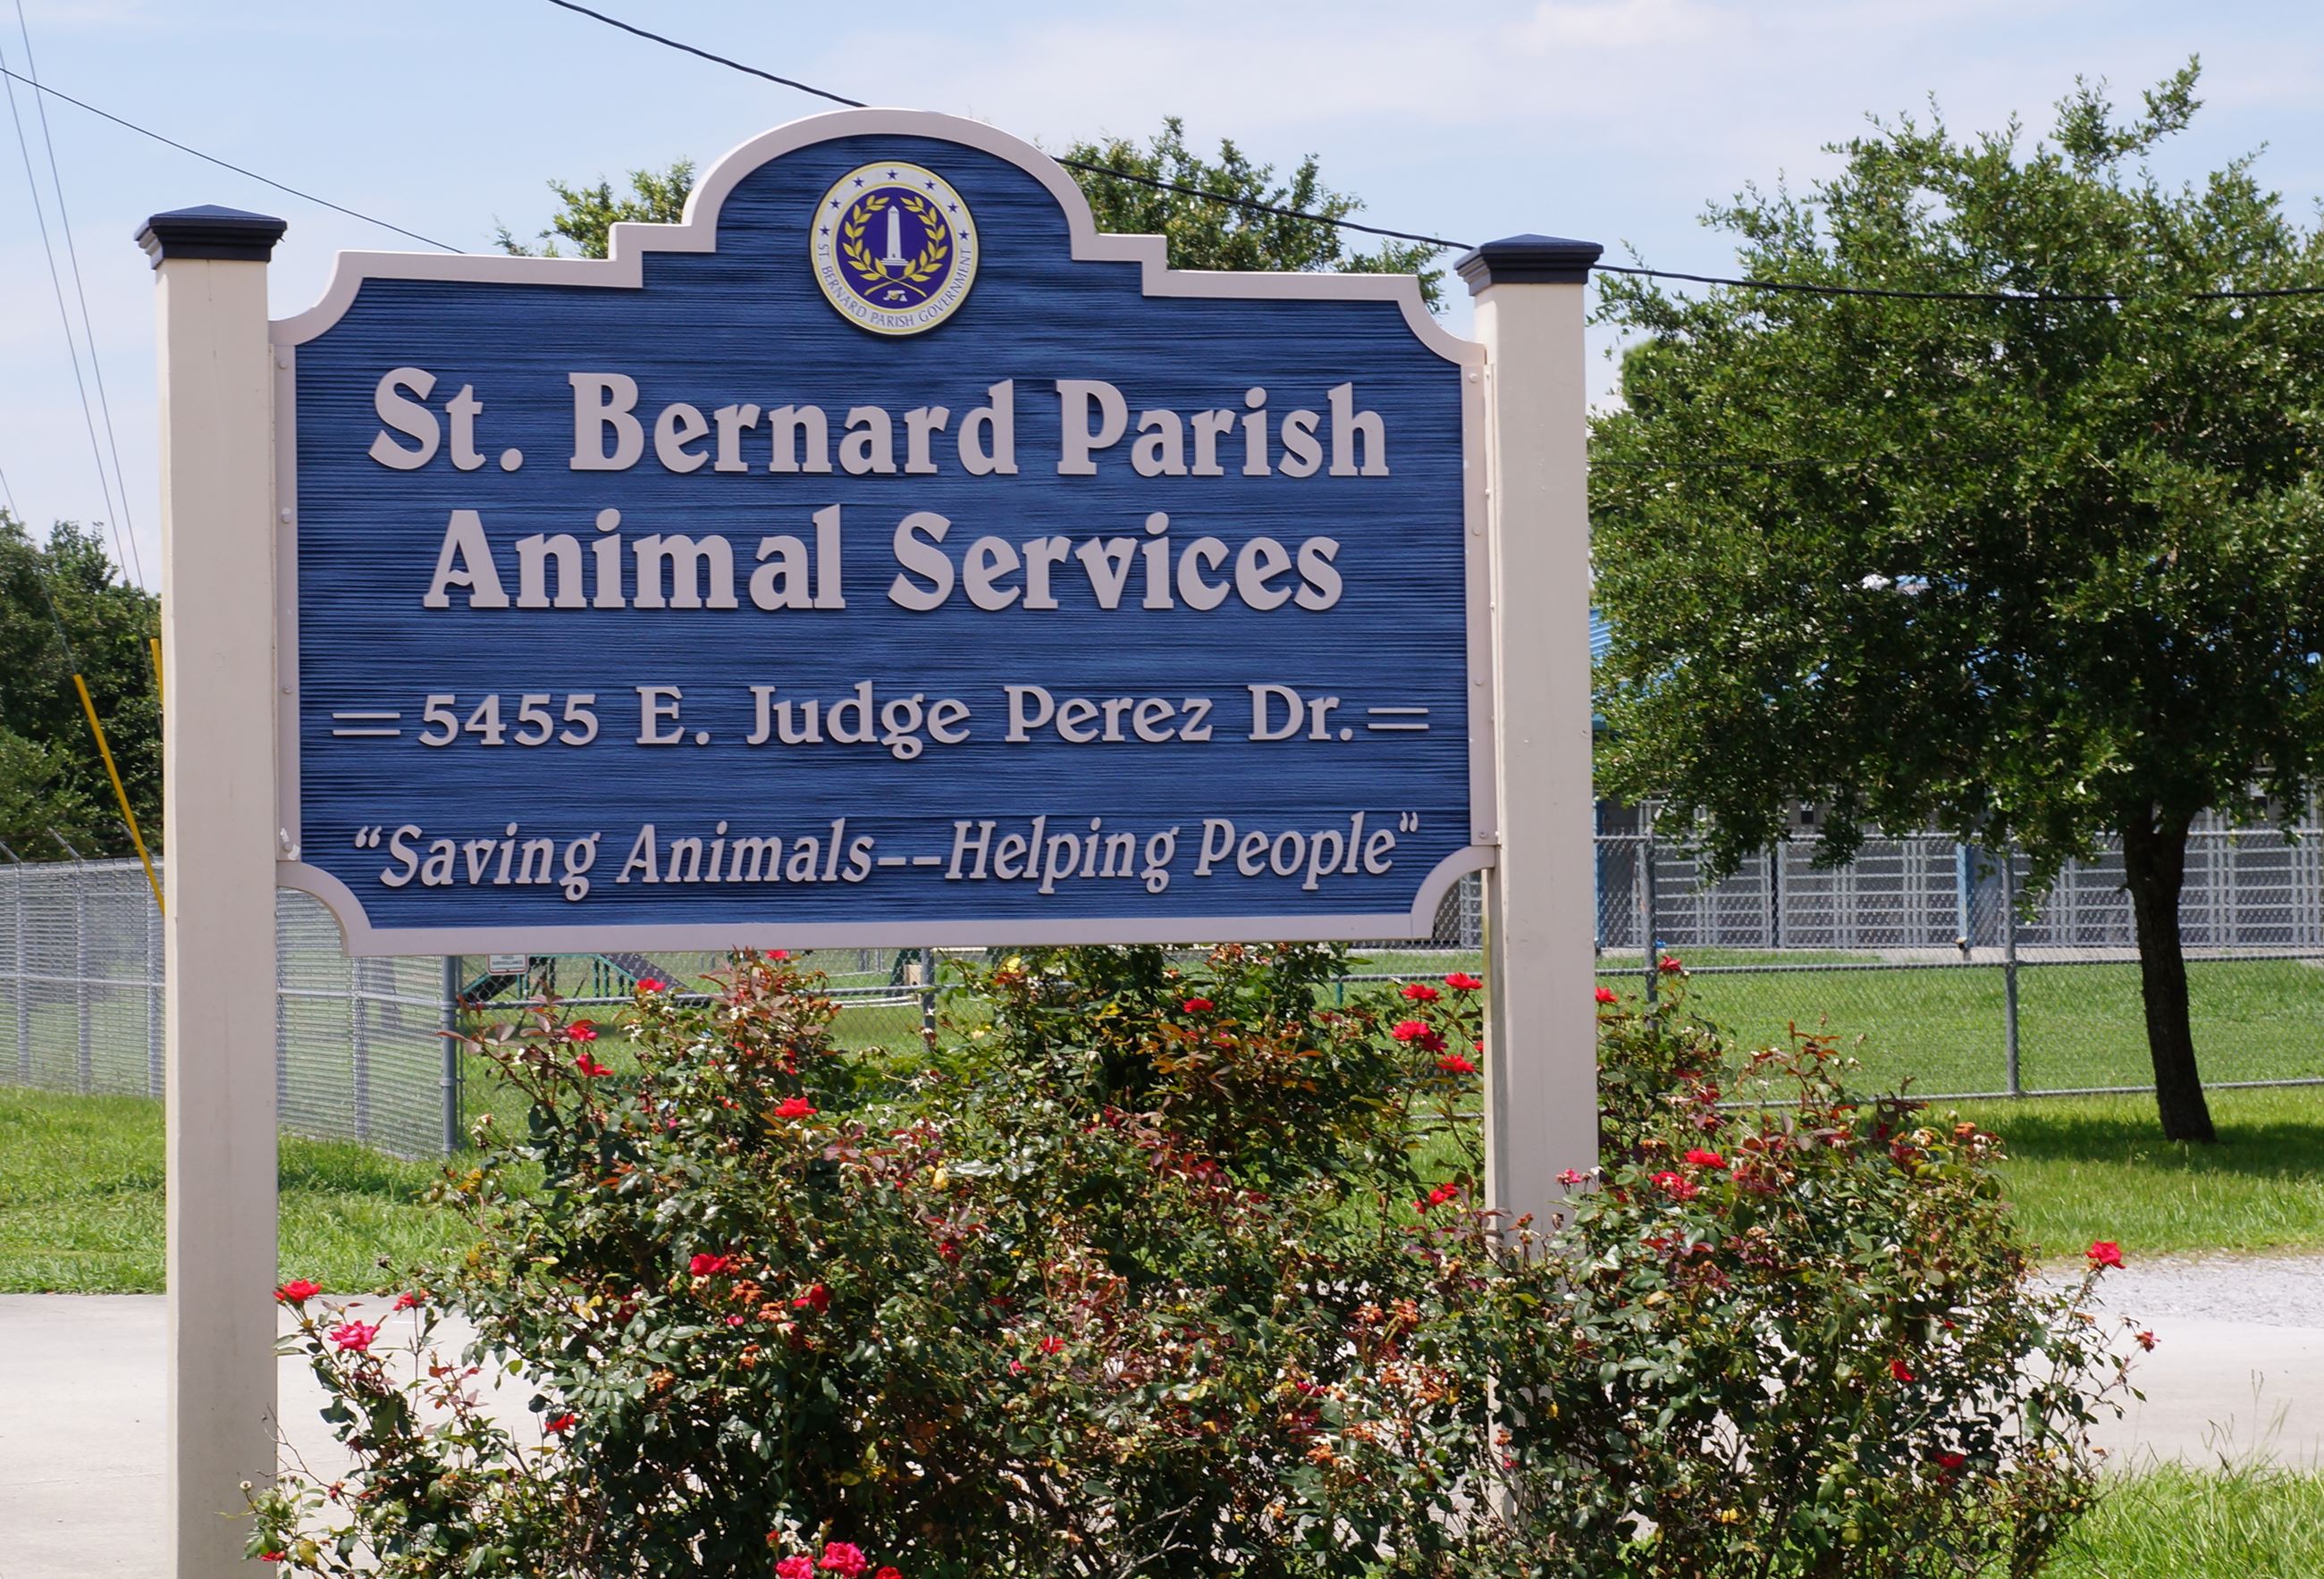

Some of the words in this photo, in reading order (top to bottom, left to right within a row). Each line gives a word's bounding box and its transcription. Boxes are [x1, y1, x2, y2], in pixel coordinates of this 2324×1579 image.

[817, 243, 829, 261] ST.
[918, 248, 973, 323] GOVERNMENT
[821, 265, 867, 318] BERNARD
[871, 311, 915, 328] PARISH
[368, 366, 523, 472] St.
[568, 372, 1018, 475] Bernard
[1056, 379, 1390, 477] Parish
[423, 503, 846, 610] Animal
[888, 511, 1343, 611] Services
[418, 693, 599, 746] 5455
[636, 685, 710, 745] E.
[746, 681, 972, 760] Judge
[1004, 685, 1213, 743] Perez
[1248, 685, 1353, 741] Dr.
